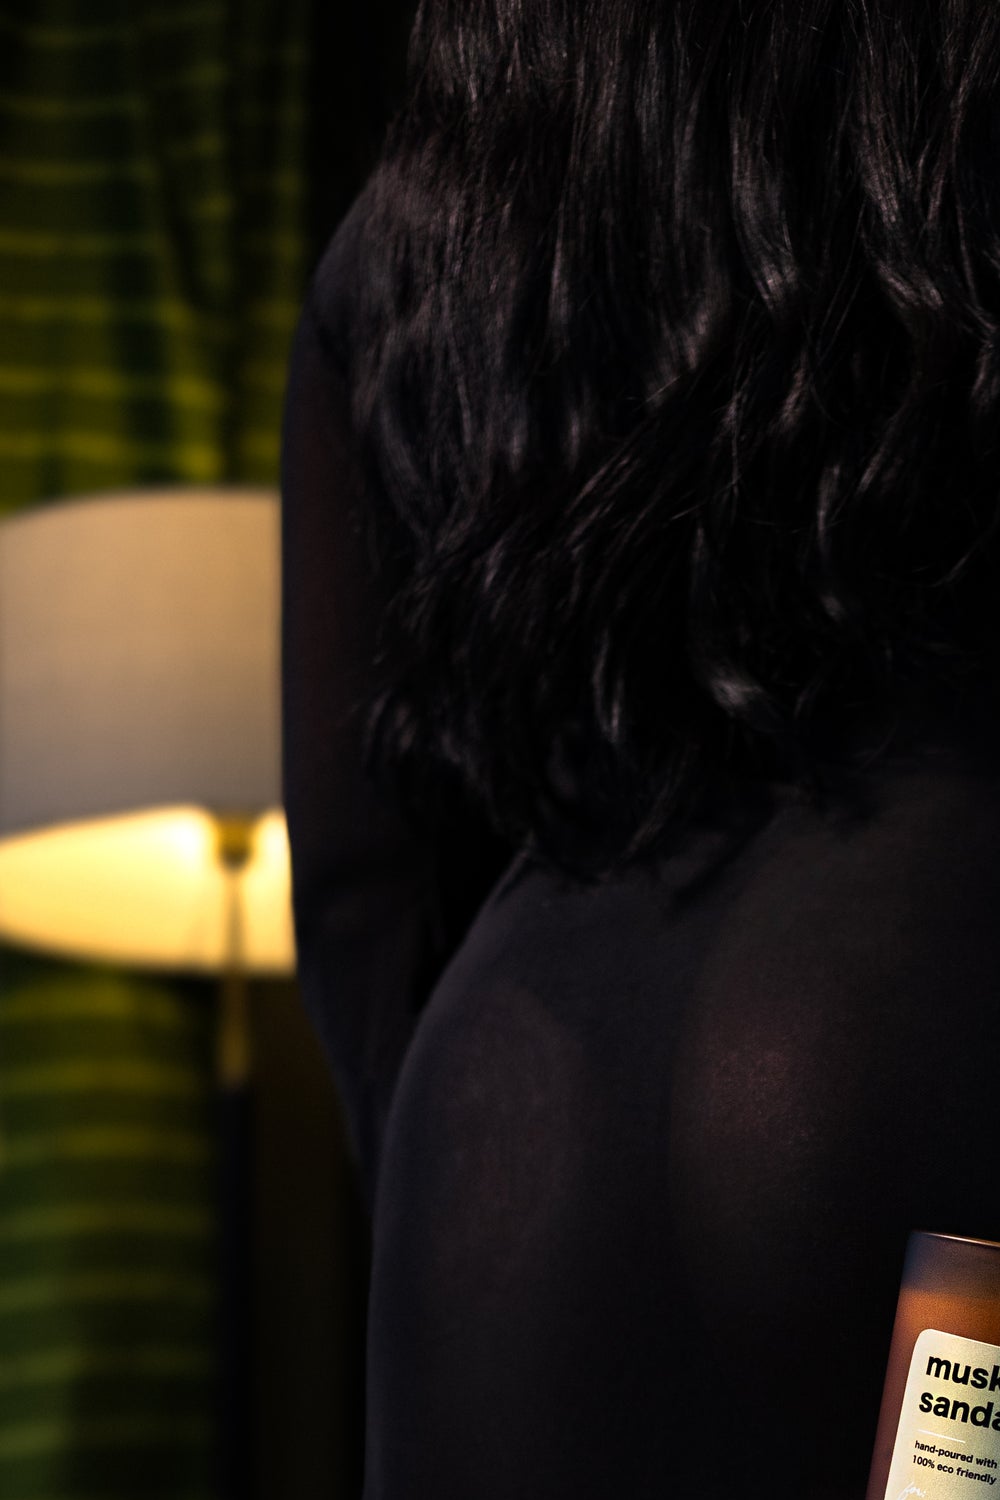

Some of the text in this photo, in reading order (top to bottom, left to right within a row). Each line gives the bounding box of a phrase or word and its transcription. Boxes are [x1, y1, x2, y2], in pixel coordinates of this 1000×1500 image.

[914, 1440, 974, 1463] hand-poured
[975, 1457, 998, 1469] with
[912, 1455, 998, 1486] 100% eco friendly
